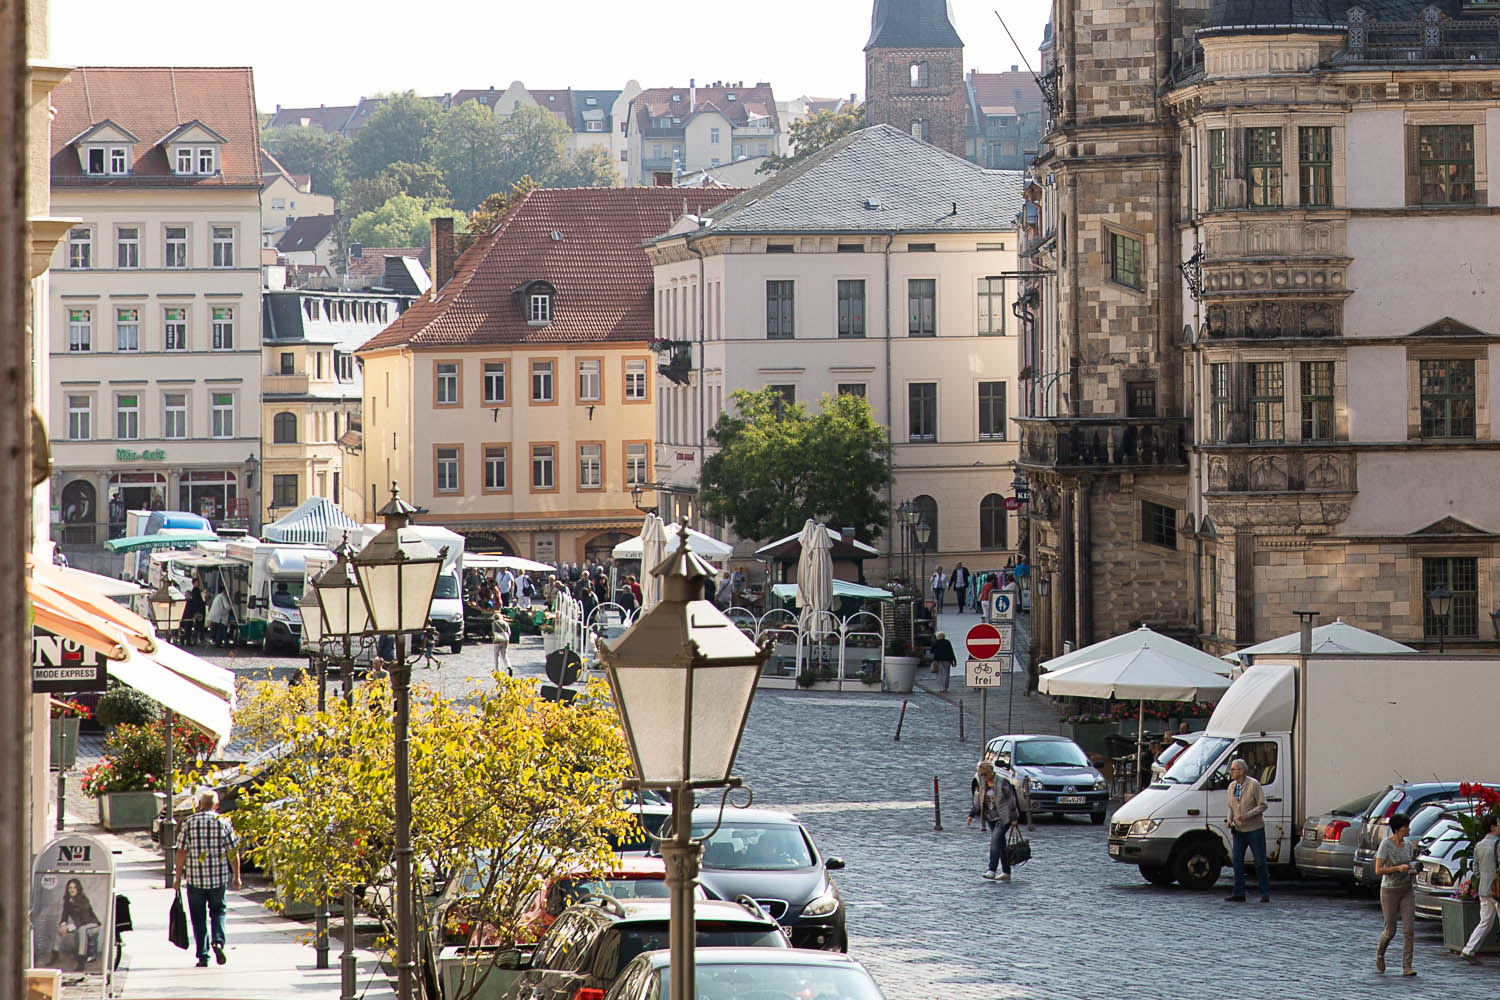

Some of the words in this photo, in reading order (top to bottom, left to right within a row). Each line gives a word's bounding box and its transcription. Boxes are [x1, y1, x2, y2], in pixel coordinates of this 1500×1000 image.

[35, 669, 59, 679] MODE
[60, 669, 95, 678] EXPRESS
[975, 676, 992, 685] frei
